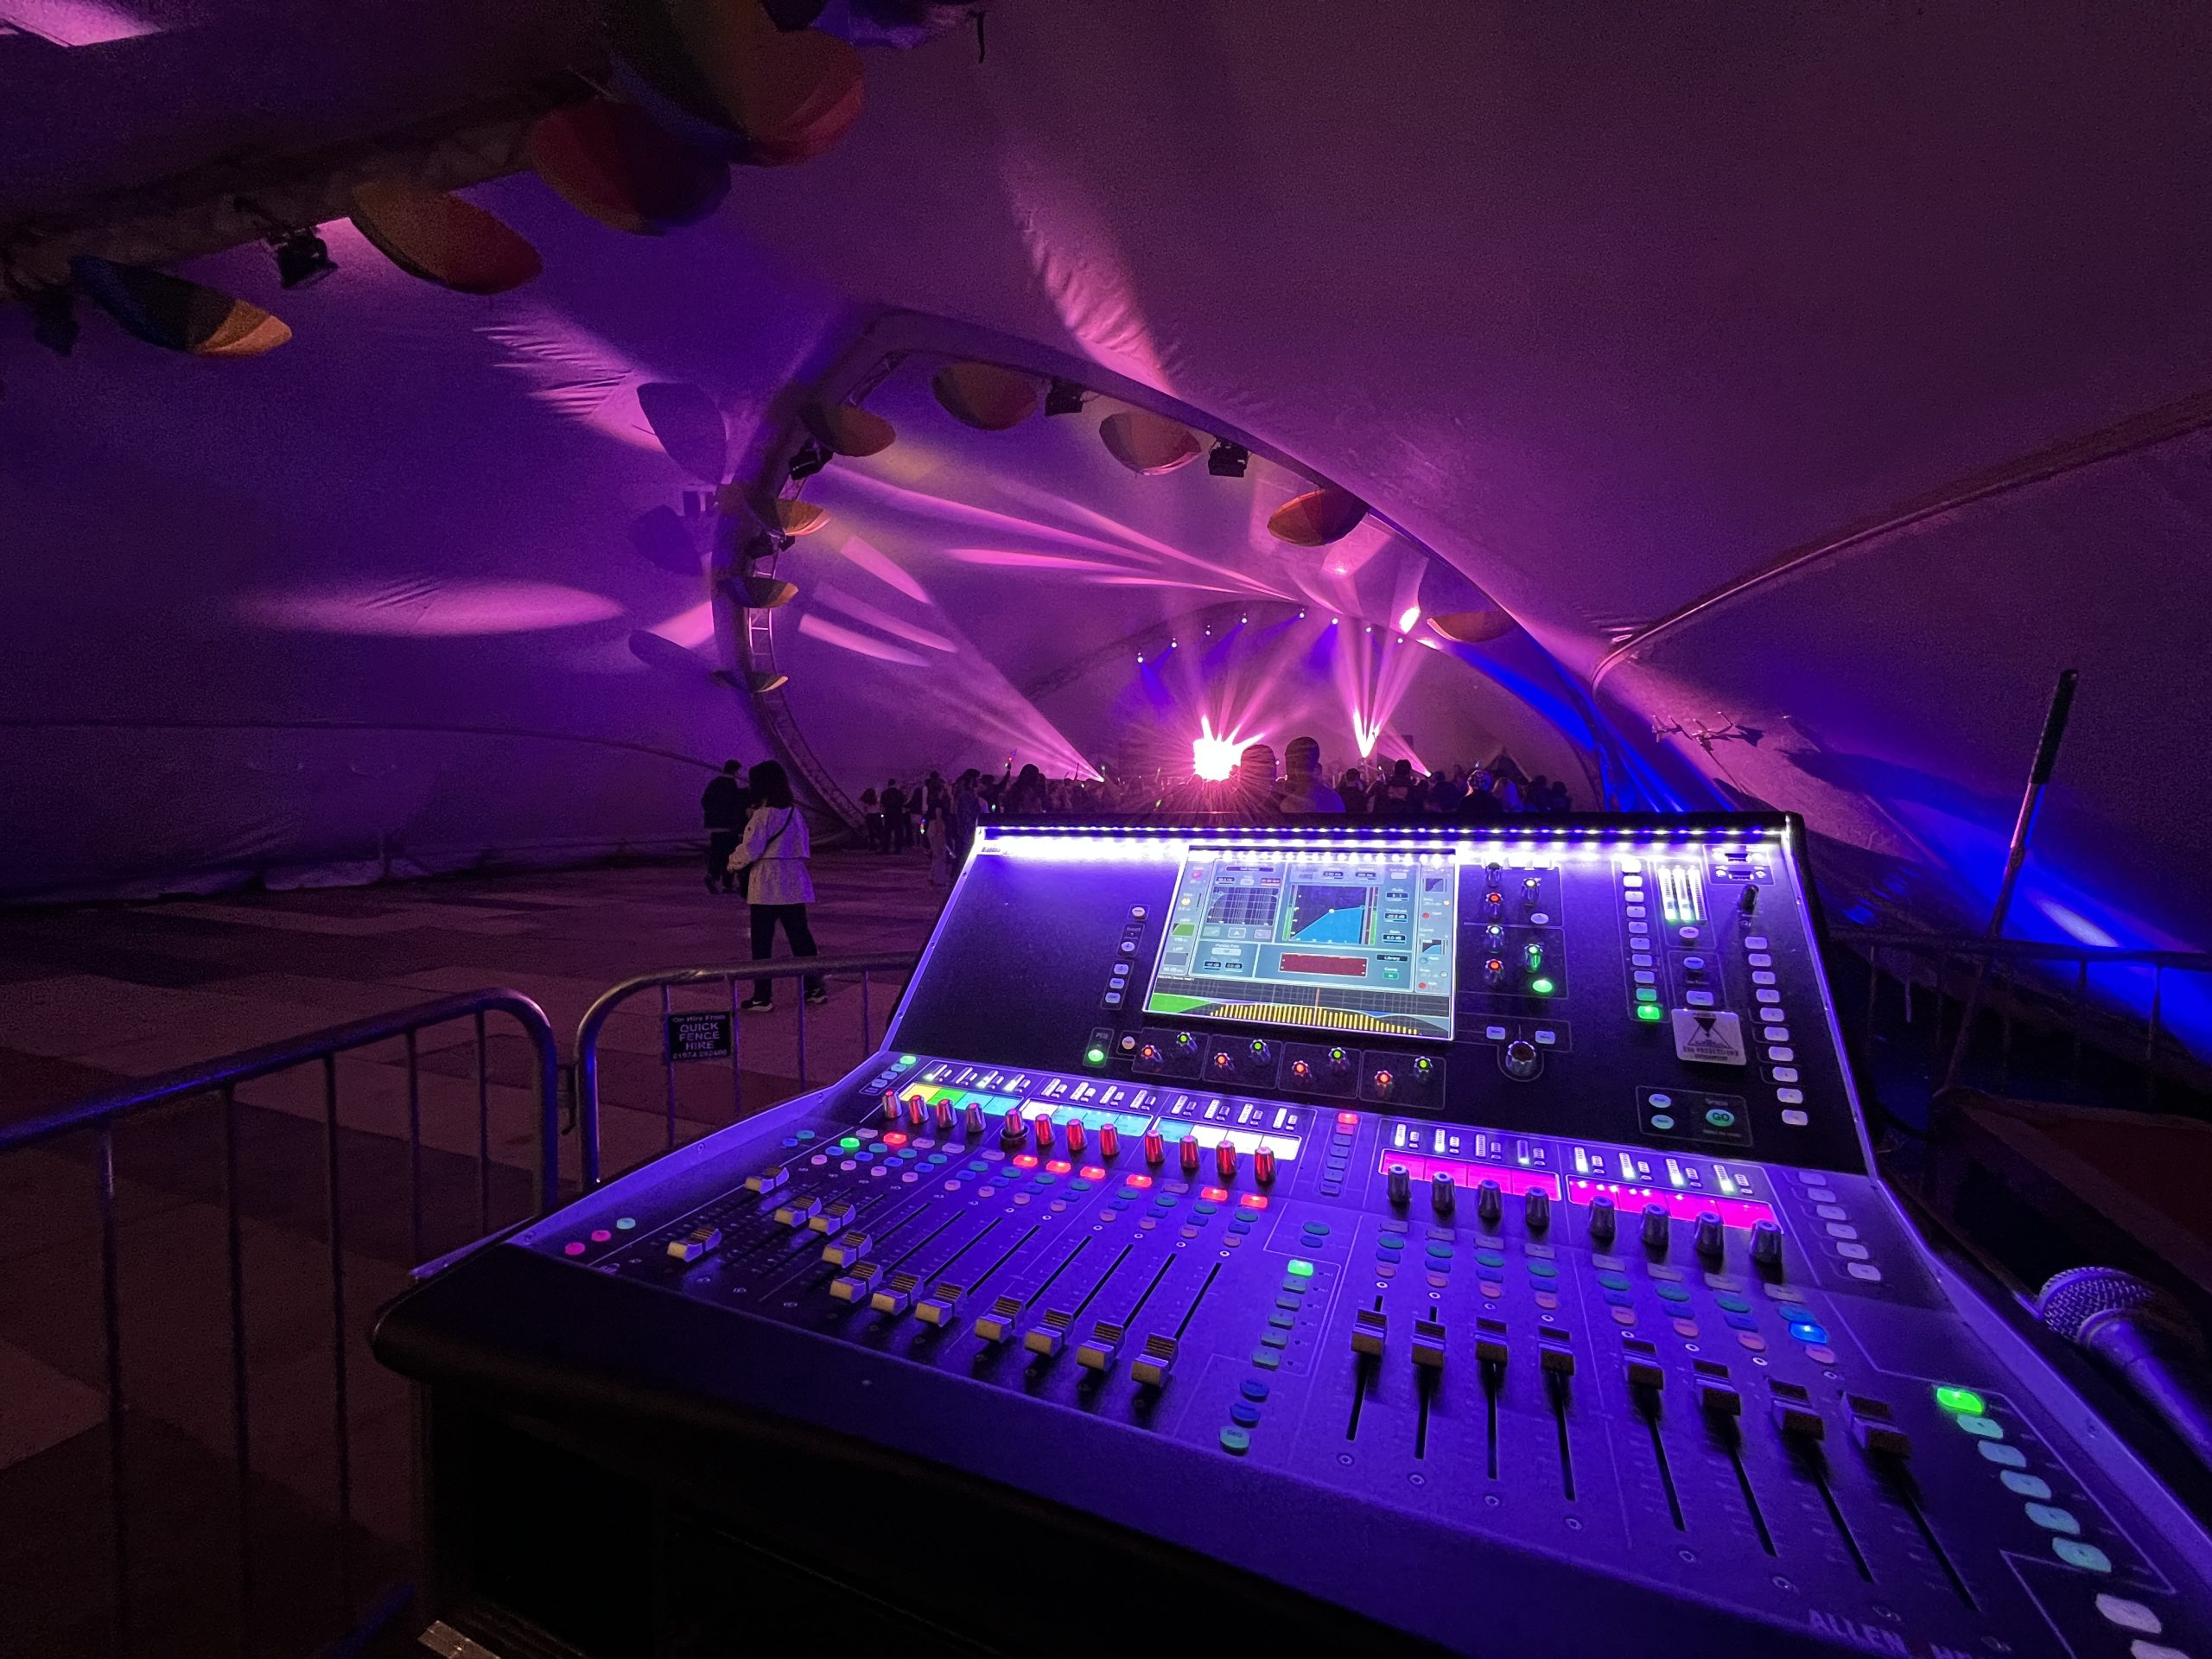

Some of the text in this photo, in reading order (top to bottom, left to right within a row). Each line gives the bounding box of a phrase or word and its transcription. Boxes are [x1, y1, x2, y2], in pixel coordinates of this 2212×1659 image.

[680, 1022, 719, 1033] QUICK
[679, 1031, 720, 1042] FENCE
[685, 1040, 715, 1051] HIRE
[1712, 1112, 1730, 1122] GO
[1808, 1608, 1910, 1656] ALLEN
